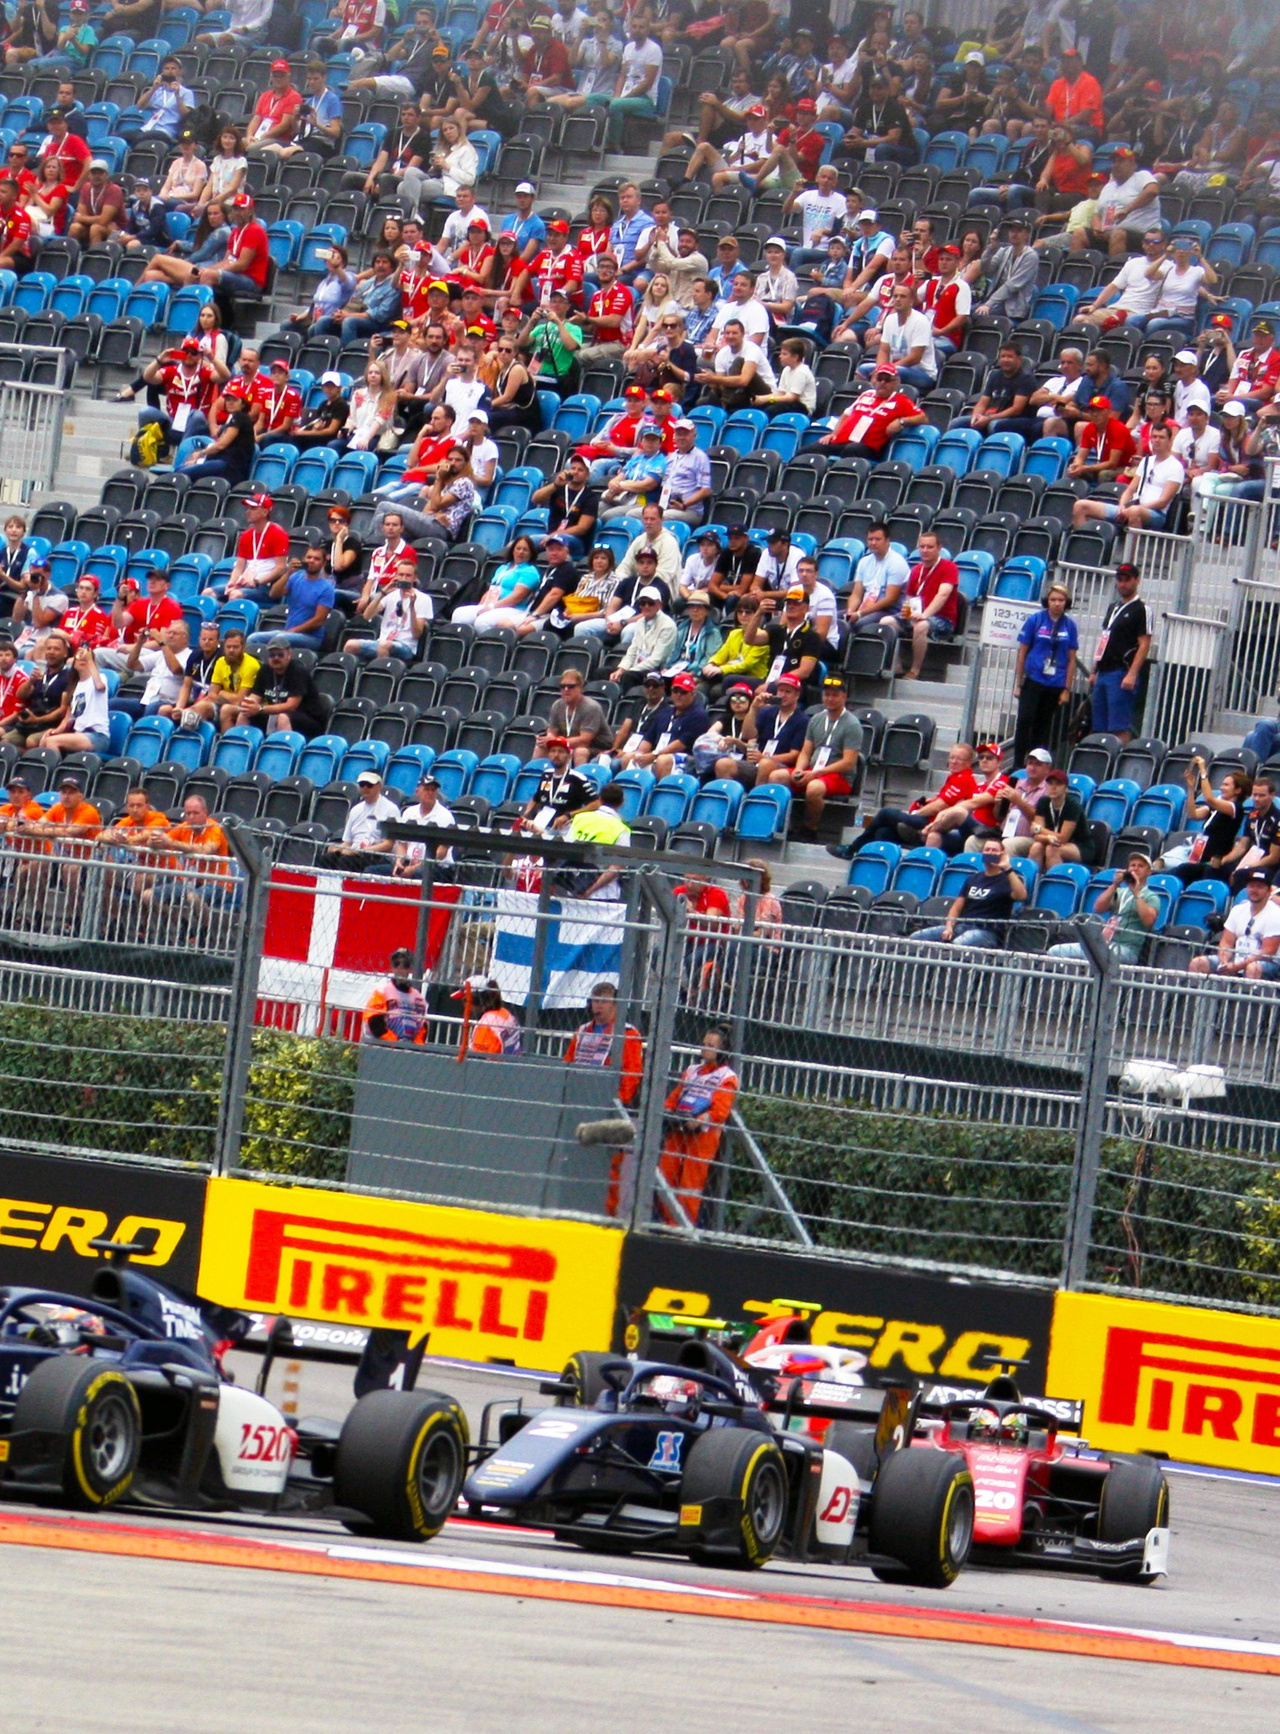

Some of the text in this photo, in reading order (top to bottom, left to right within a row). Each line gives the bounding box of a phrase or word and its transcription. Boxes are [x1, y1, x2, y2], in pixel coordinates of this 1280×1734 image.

[968, 886, 991, 897] EA7
[244, 1209, 557, 1341] PIRELLI
[388, 1363, 406, 1391] 1
[529, 1421, 579, 1439] 2
[974, 1489, 1016, 1510] 20
